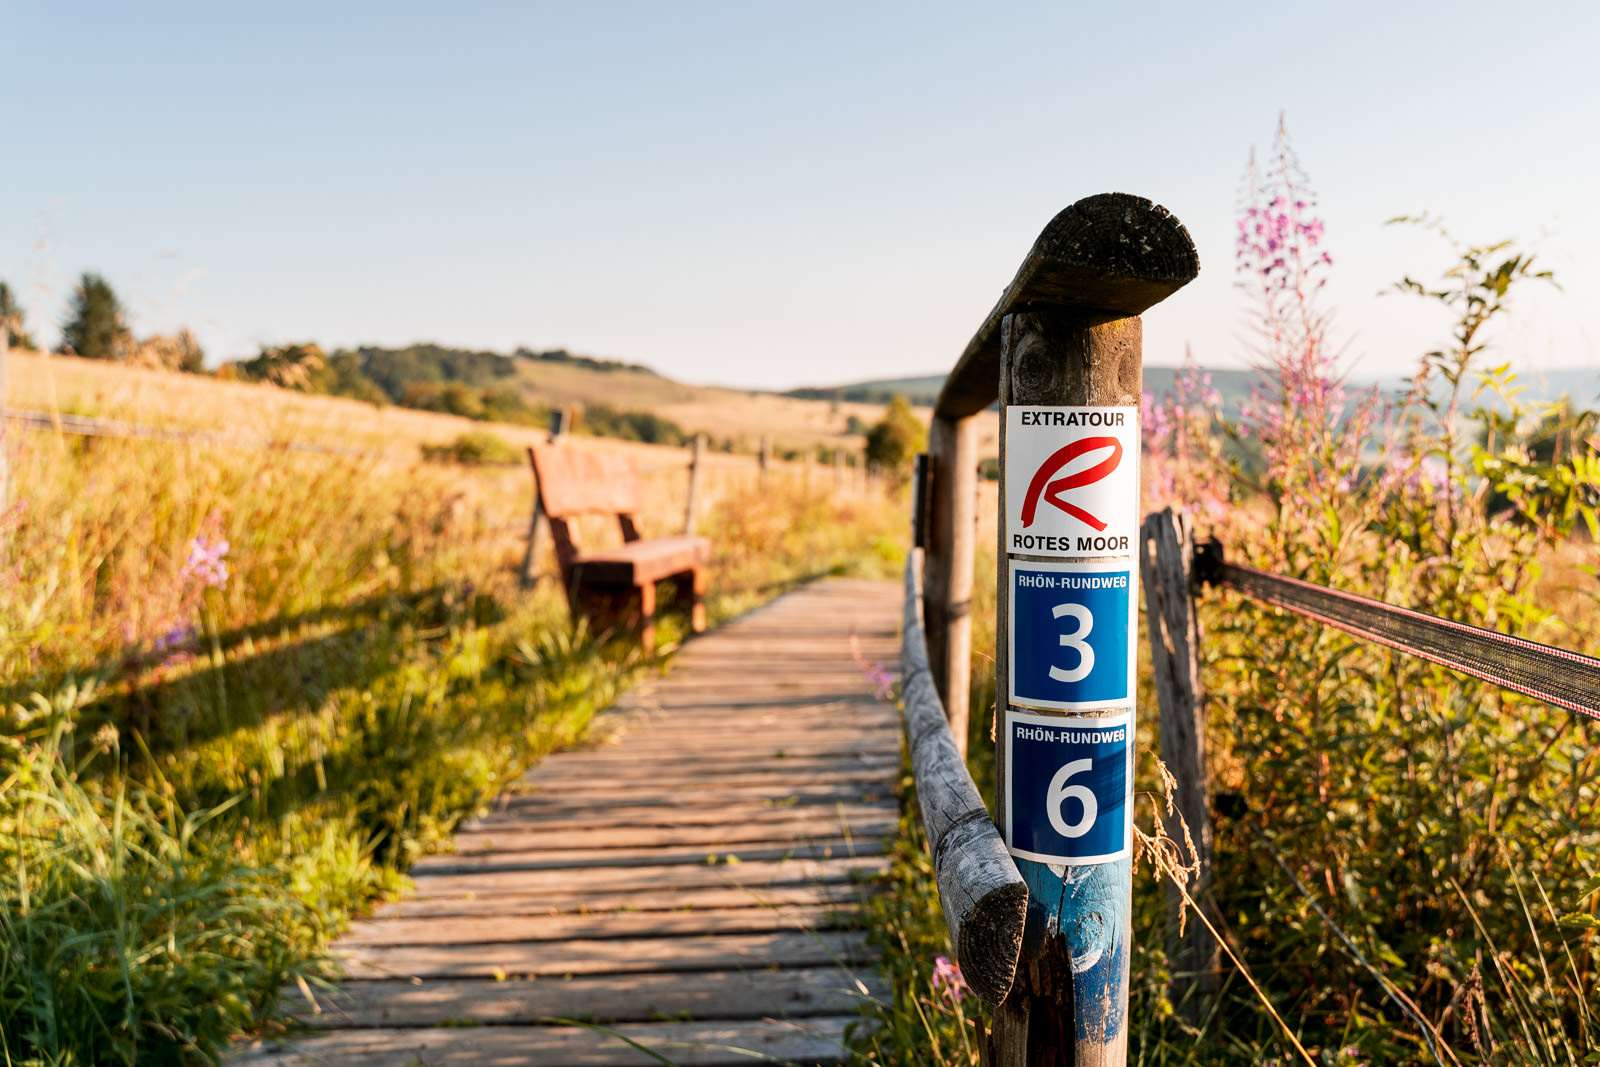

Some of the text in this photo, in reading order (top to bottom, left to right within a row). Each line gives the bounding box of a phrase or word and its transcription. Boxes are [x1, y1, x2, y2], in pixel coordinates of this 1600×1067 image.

[1021, 411, 1125, 427] EXTRATOUR
[1021, 436, 1123, 532] R
[1013, 534, 1129, 551] ROTES MOOR
[1018, 574, 1127, 589] RHÖN-RUNDWEG
[1048, 602, 1095, 683] 3
[1016, 727, 1125, 744] RHÖN-RUNDWEG
[1046, 758, 1098, 838] 6
